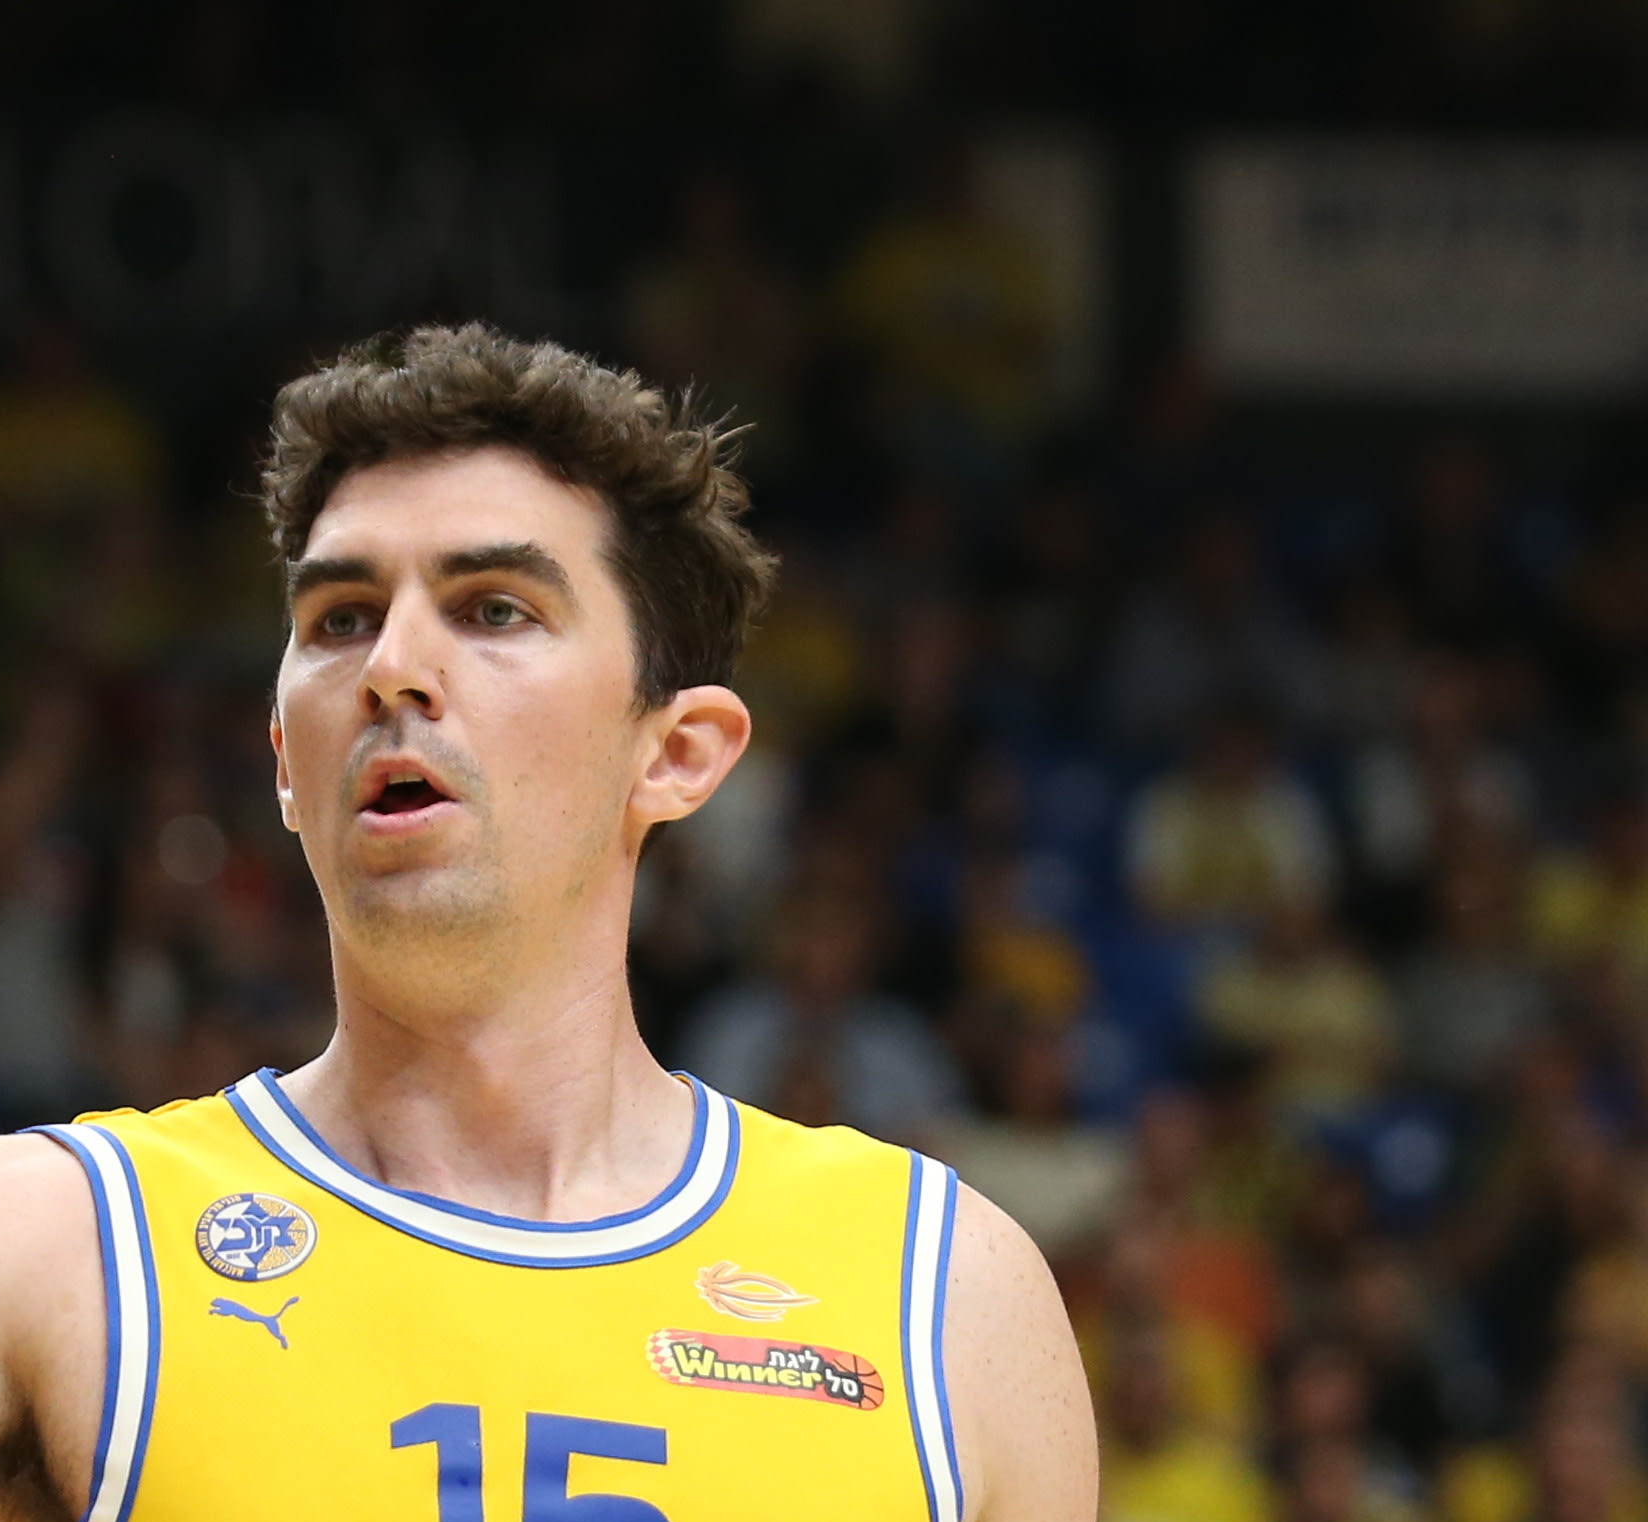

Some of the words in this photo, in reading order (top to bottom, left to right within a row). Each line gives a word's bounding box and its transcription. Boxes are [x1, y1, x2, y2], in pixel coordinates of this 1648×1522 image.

[672, 1343, 822, 1389] Winner
[768, 1347, 820, 1370] ליגת
[824, 1367, 859, 1396] סל
